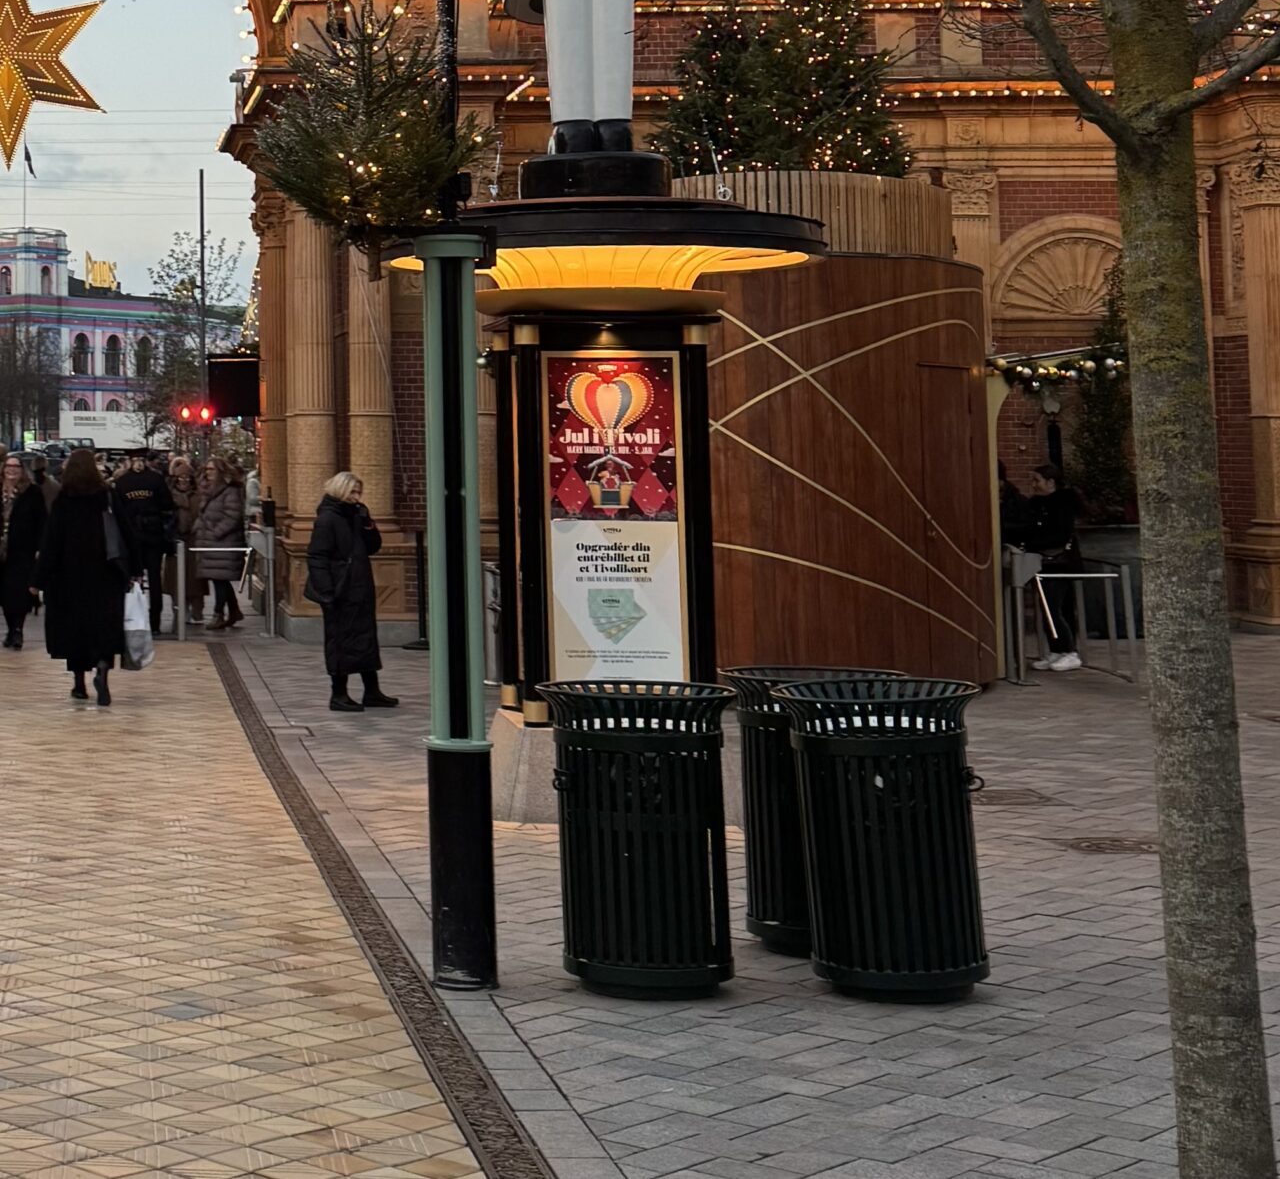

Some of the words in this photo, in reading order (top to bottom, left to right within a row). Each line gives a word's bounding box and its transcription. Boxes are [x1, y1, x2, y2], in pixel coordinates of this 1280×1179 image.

[559, 428, 589, 444] Jul
[592, 428, 600, 444] i
[603, 428, 660, 444] Tivoli
[576, 542, 630, 553] Opgradér
[631, 542, 651, 552] din
[577, 553, 635, 562] entrébillet
[637, 553, 650, 562] til
[579, 564, 589, 573] et
[591, 563, 648, 573] Tivolikort
